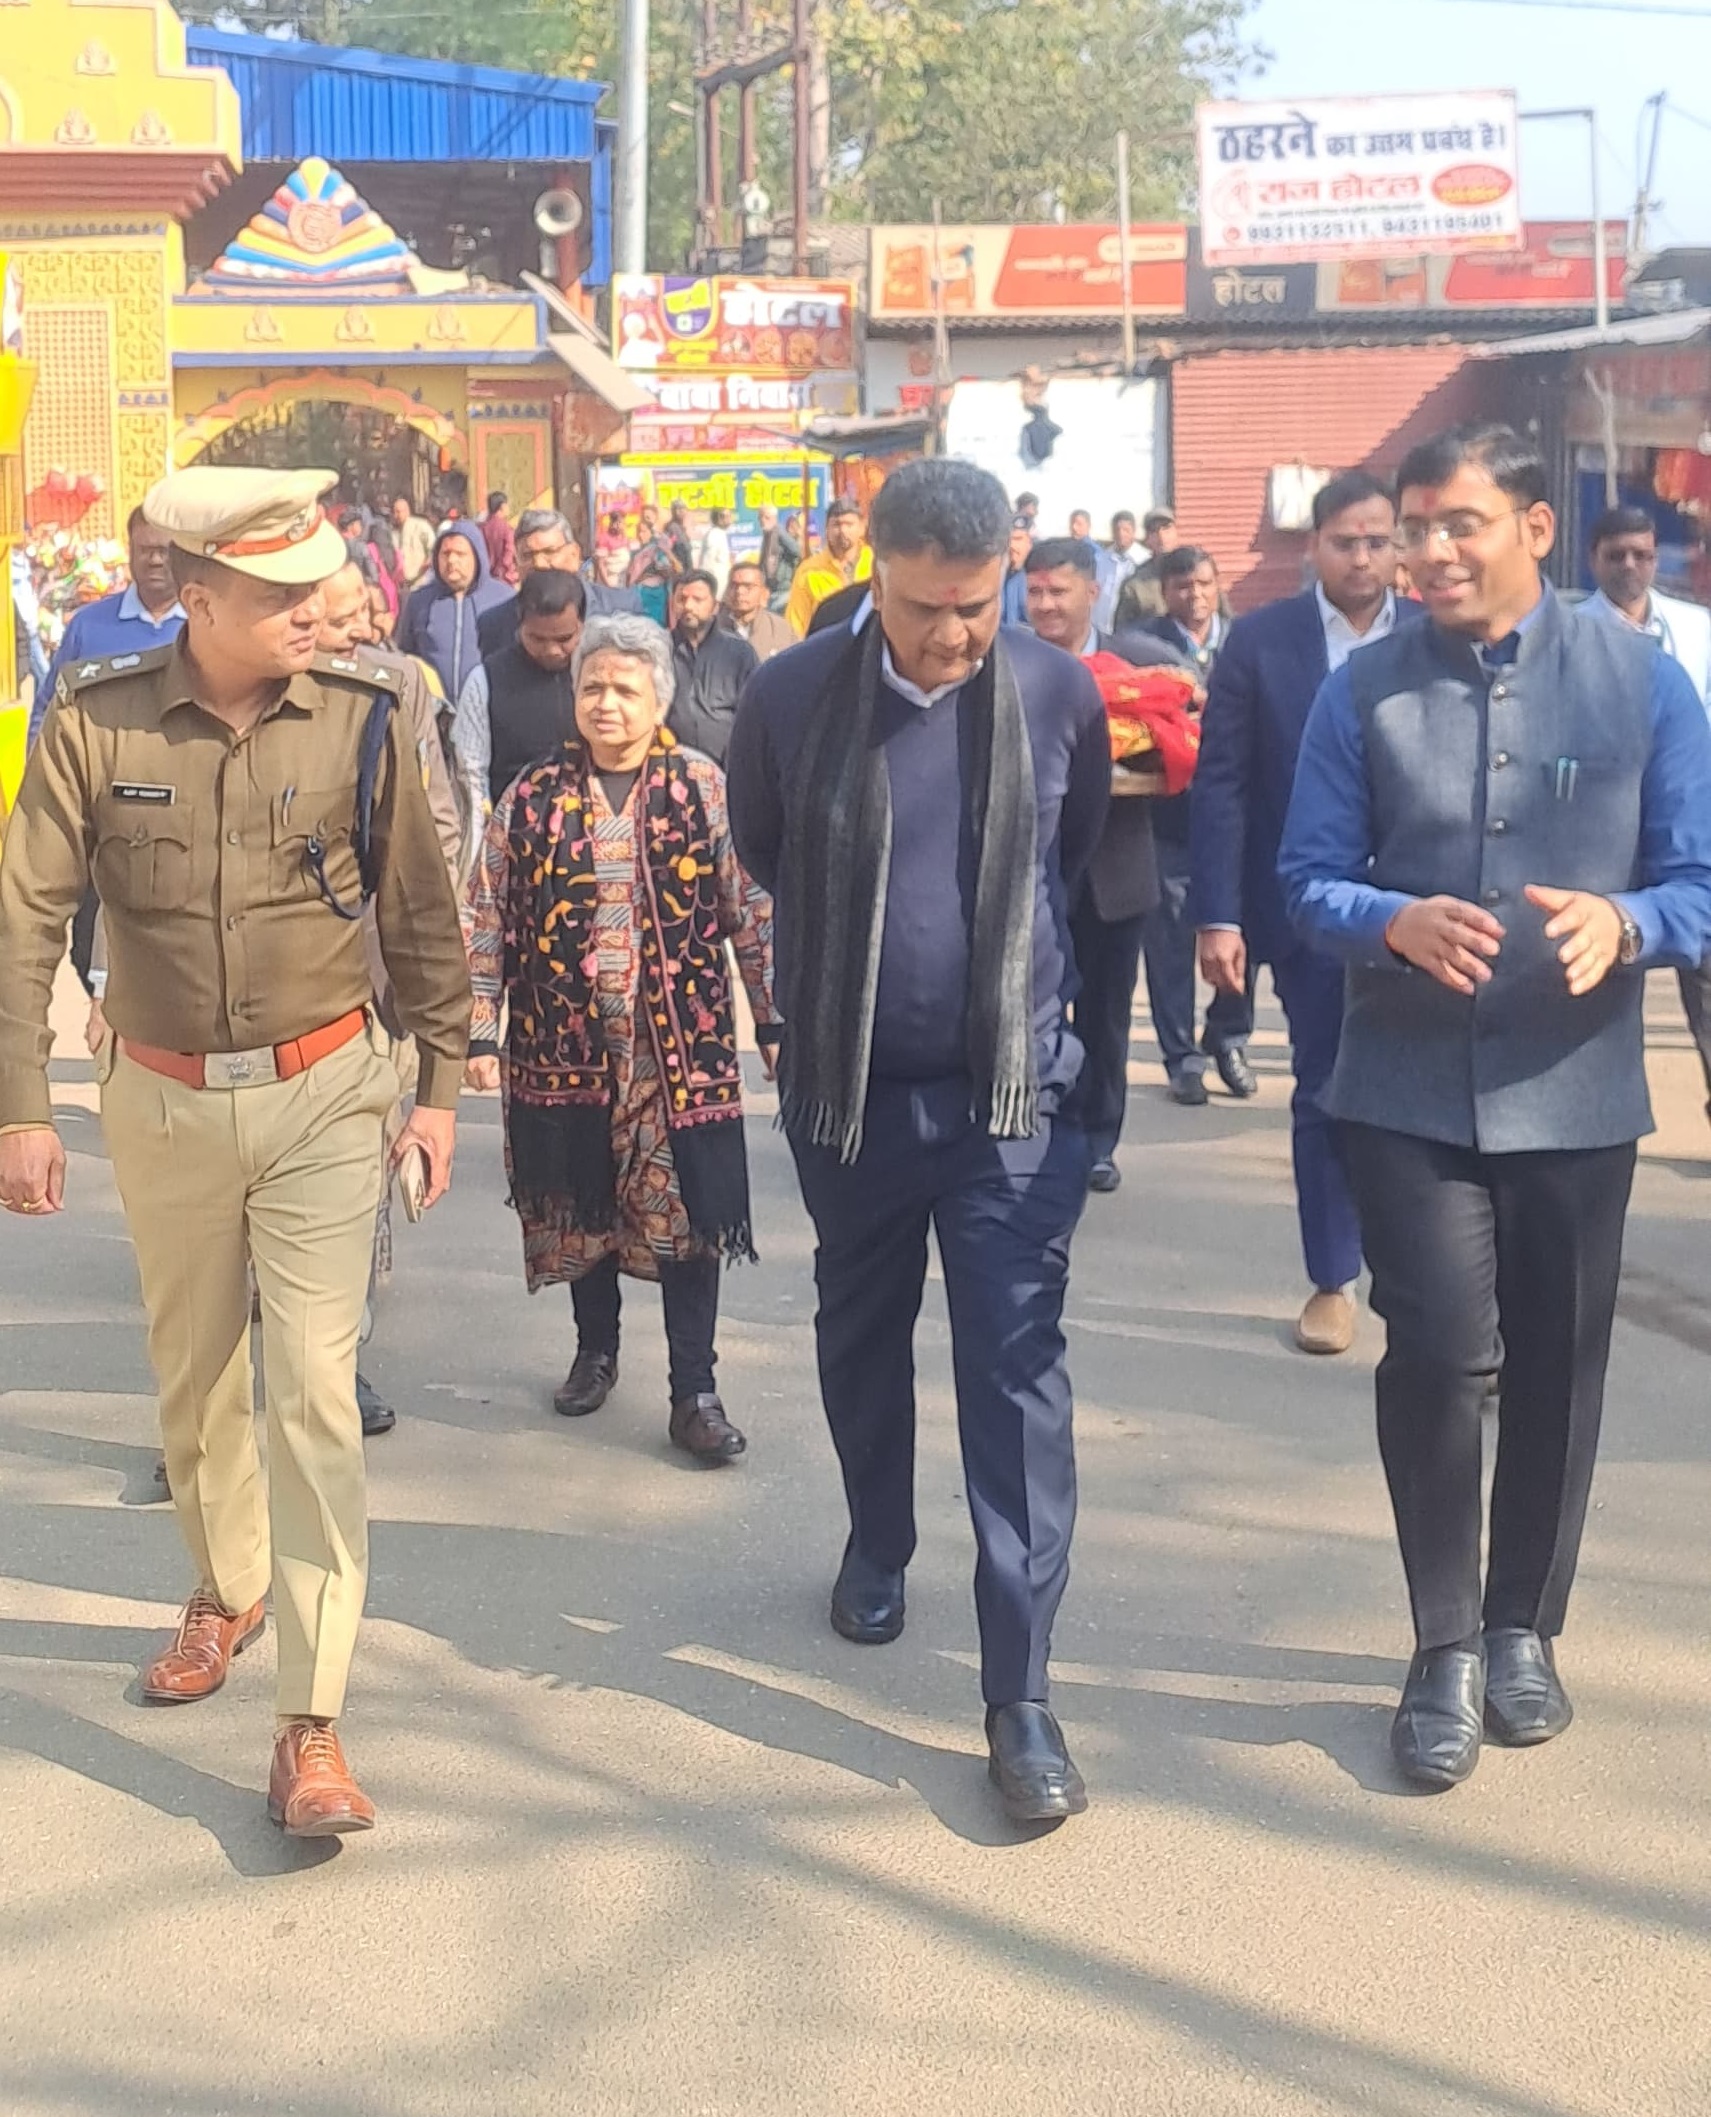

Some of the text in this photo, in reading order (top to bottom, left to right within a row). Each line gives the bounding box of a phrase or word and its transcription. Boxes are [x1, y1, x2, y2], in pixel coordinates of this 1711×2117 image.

[1213, 109, 1319, 163] ठहरने
[1325, 132, 1357, 157] का
[1329, 172, 1423, 203] होटल
[719, 281, 848, 329] होटल
[1211, 268, 1287, 307] होटल
